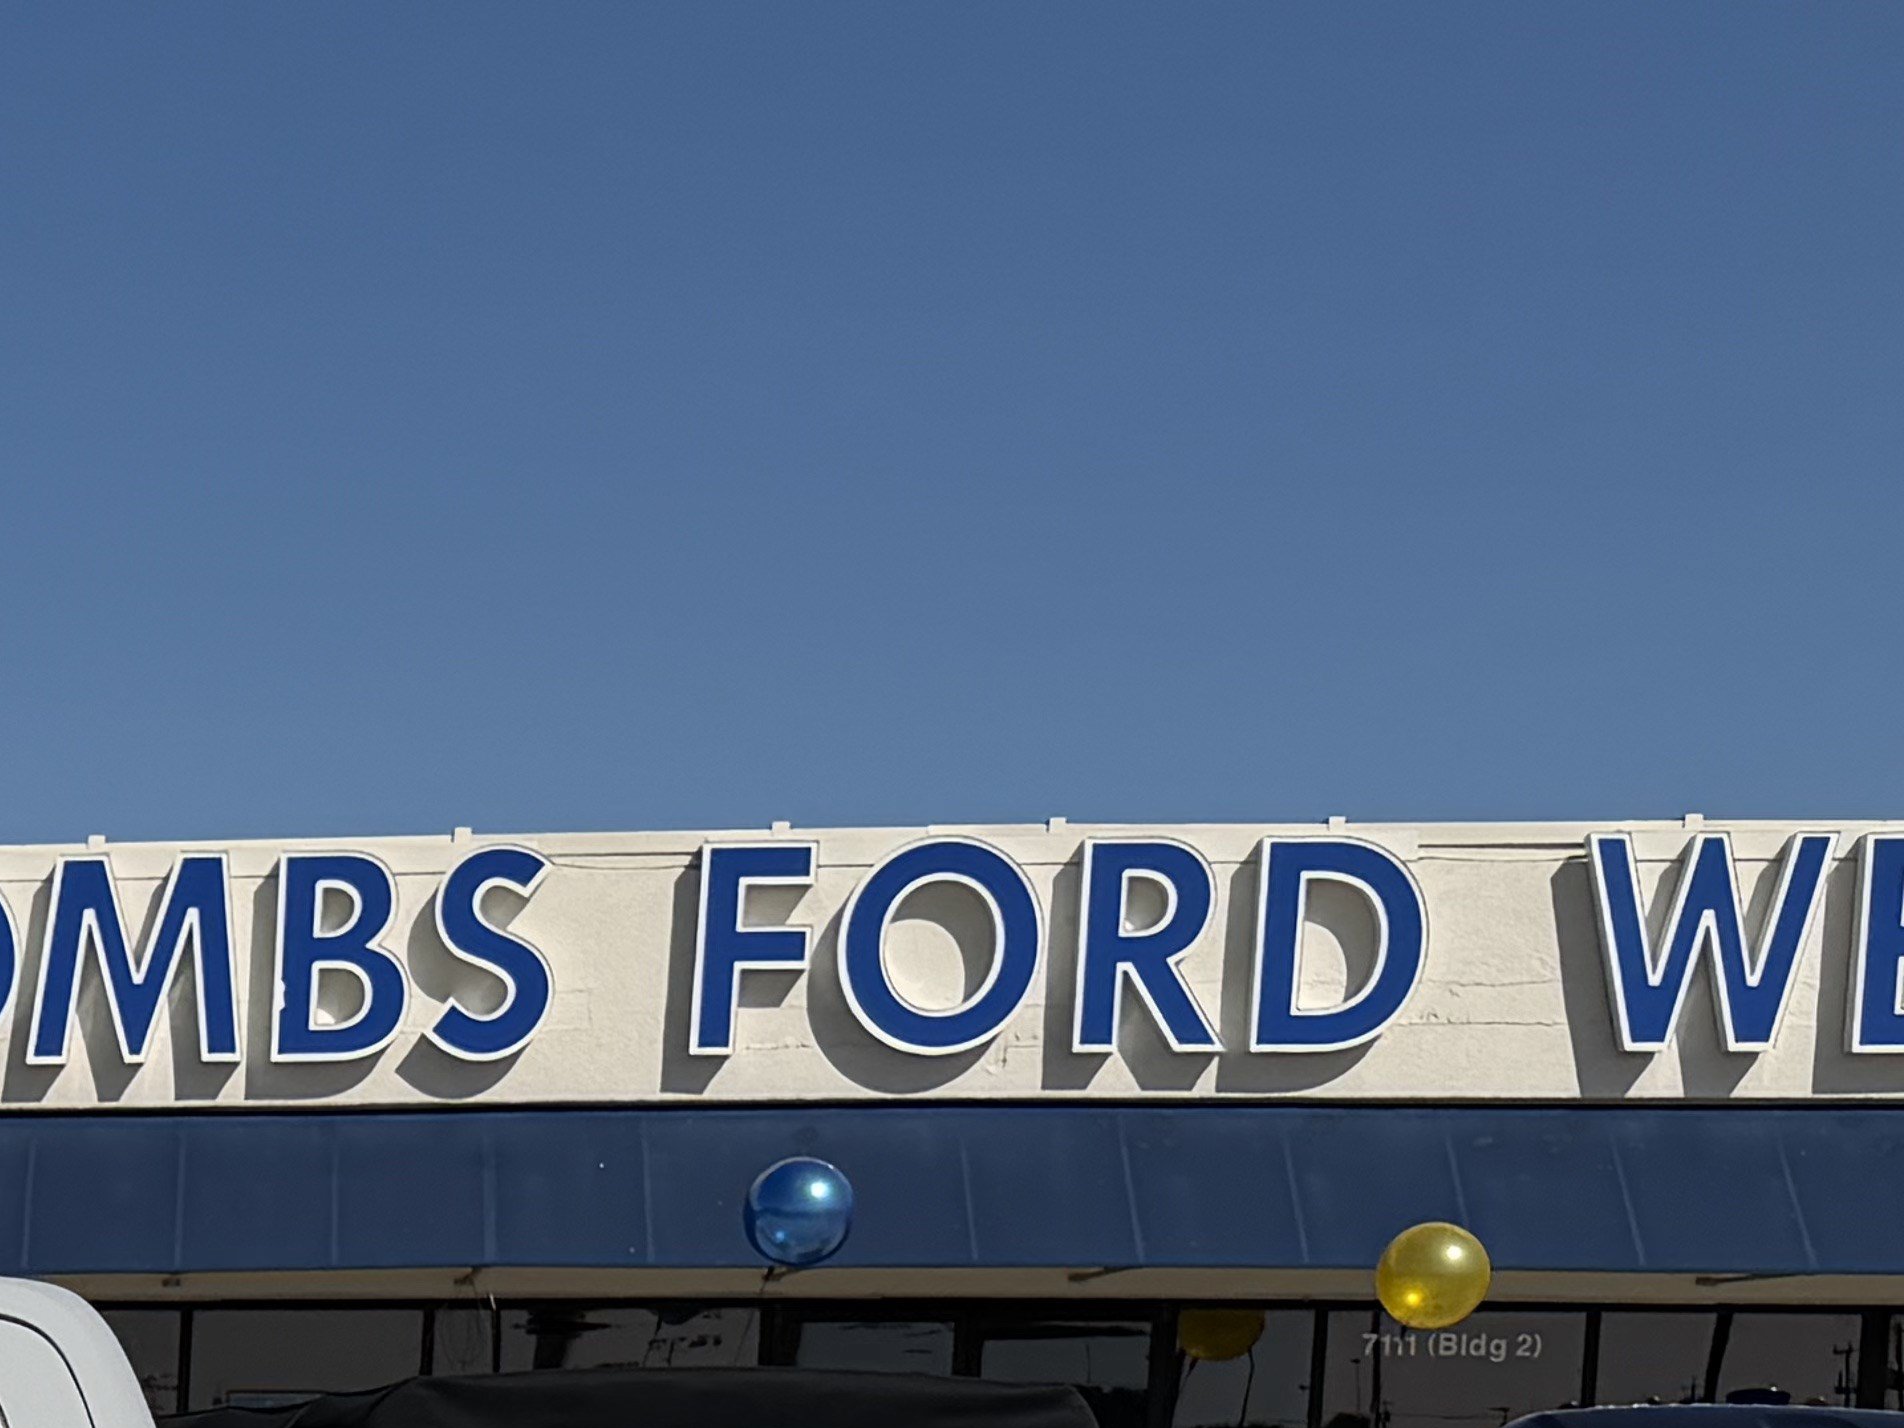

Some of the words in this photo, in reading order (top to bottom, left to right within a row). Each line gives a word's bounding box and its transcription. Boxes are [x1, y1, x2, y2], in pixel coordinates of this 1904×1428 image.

[688, 835, 1430, 1057] FORD
[1428, 1331, 1508, 1363] (Bldg
[1515, 1333, 1542, 1358] 2)
